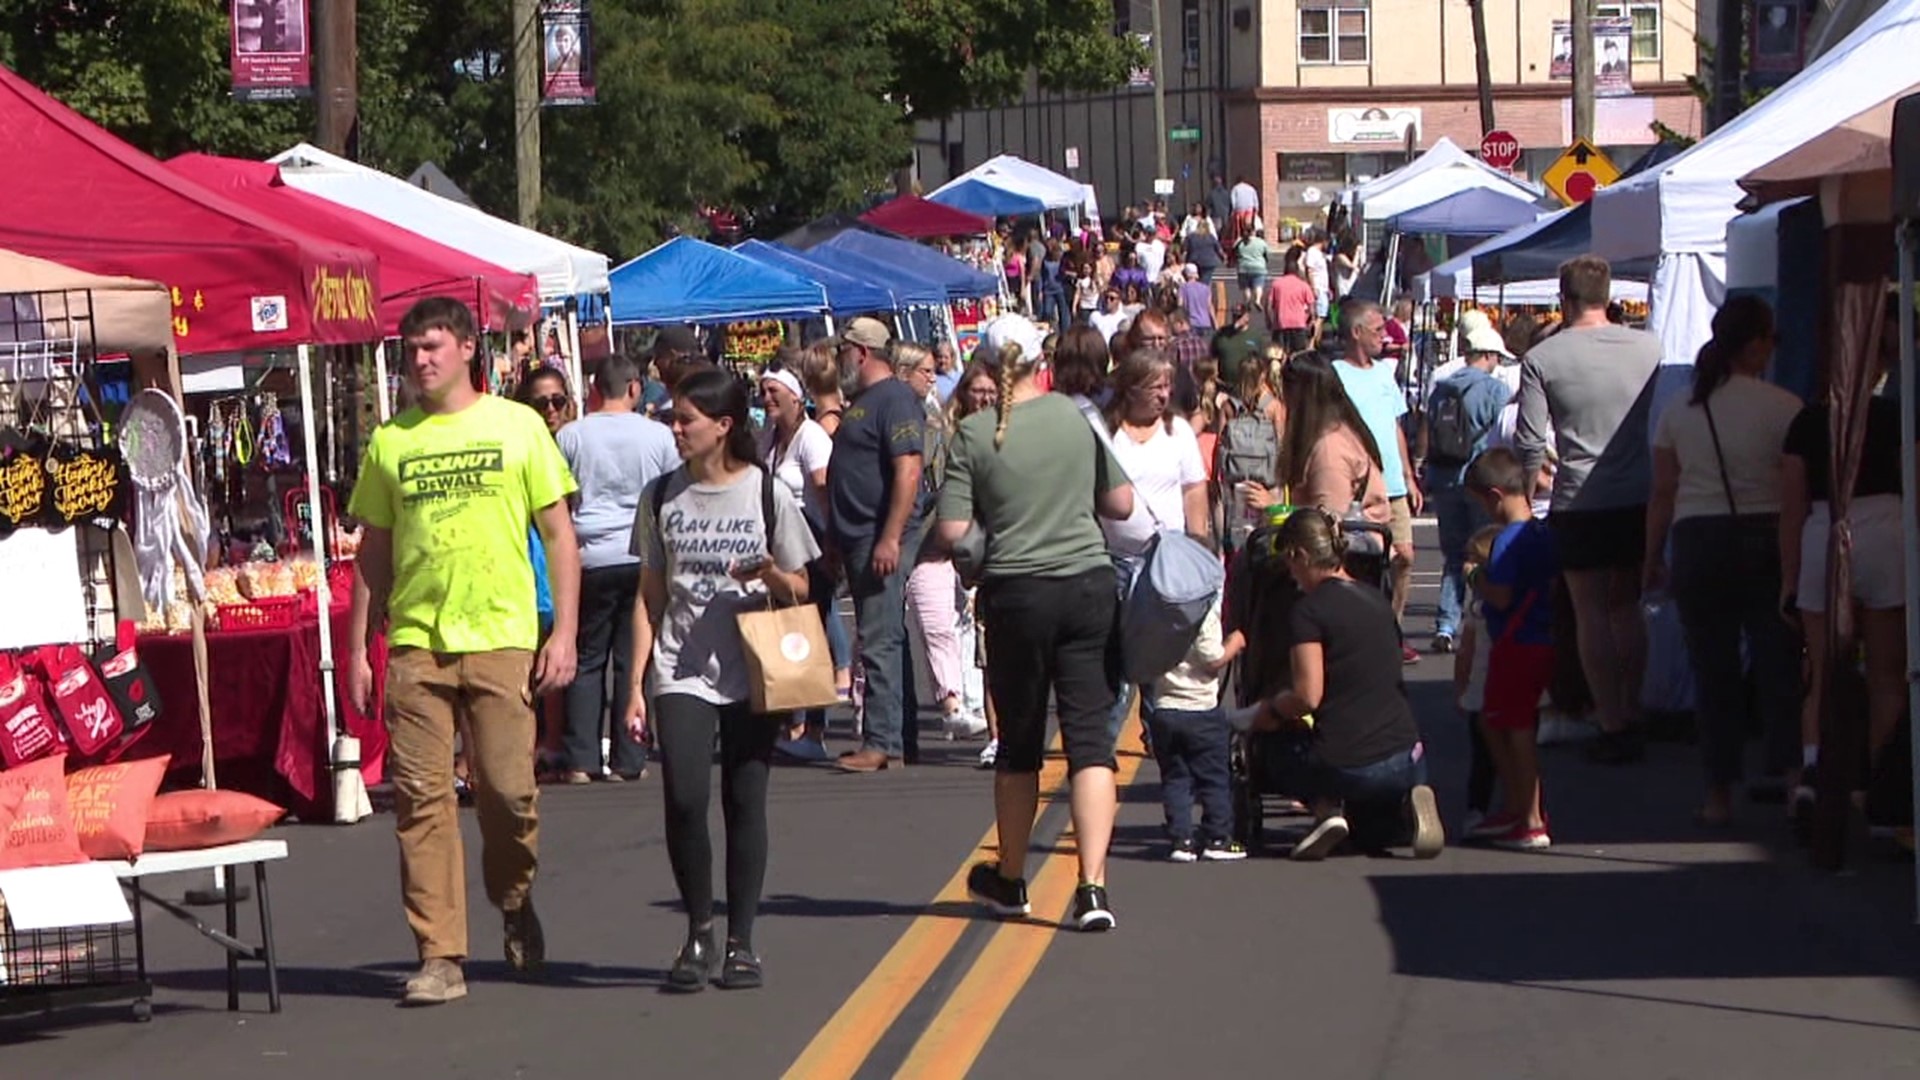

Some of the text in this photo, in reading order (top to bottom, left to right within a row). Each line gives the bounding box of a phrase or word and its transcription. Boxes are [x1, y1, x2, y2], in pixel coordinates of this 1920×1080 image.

[1482, 141, 1517, 157] STOP
[665, 510, 755, 533] PLAY LIKE
